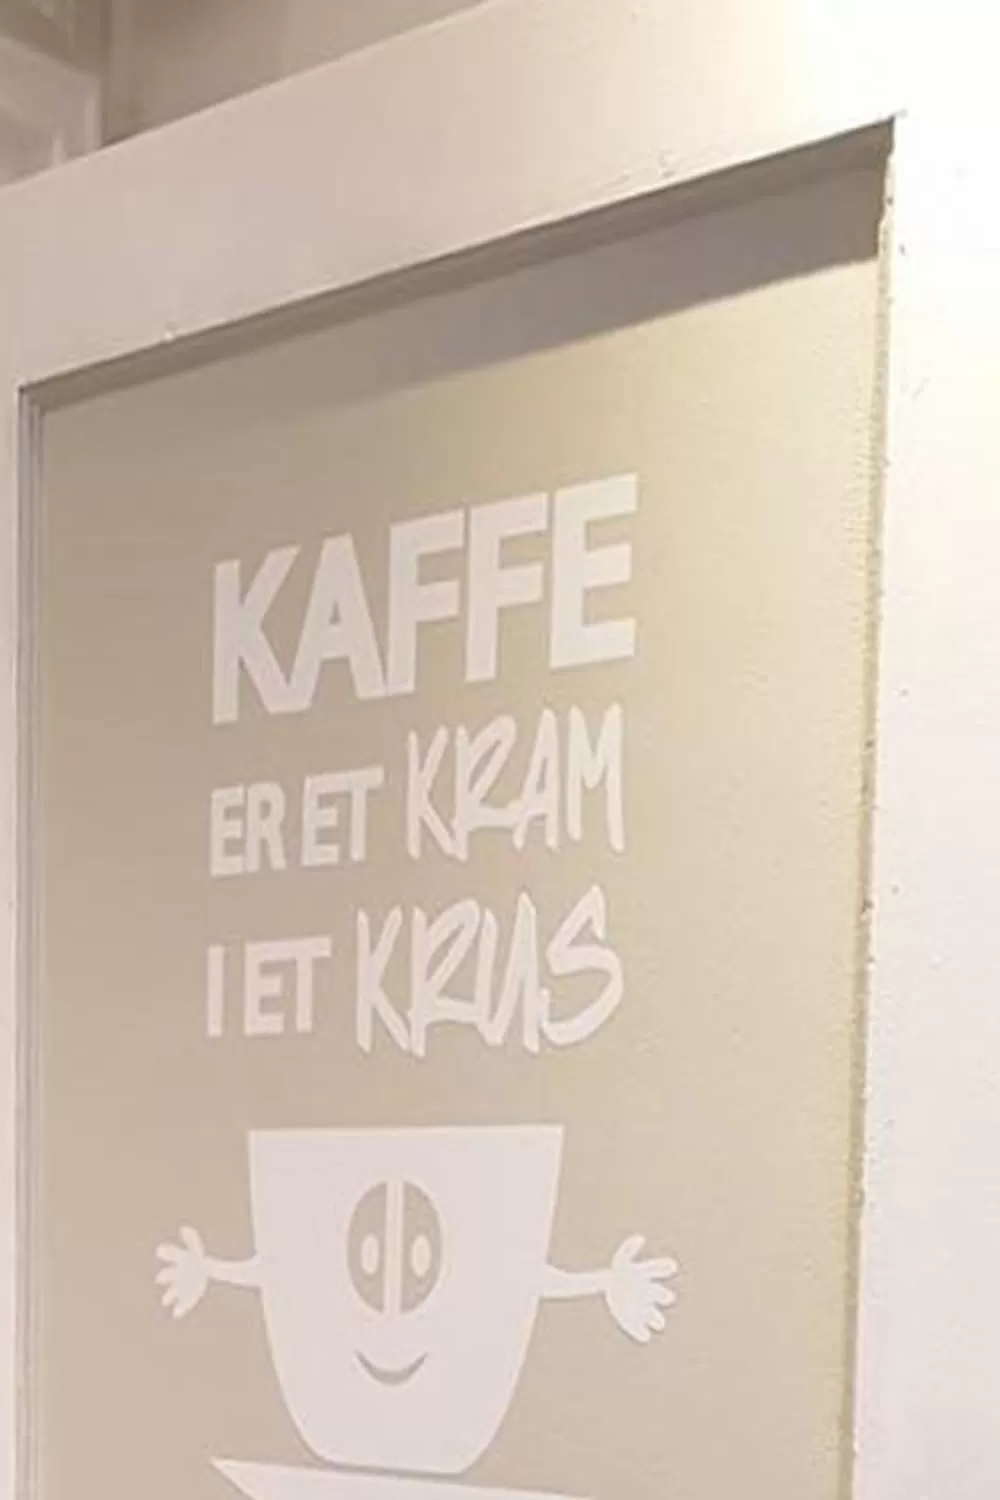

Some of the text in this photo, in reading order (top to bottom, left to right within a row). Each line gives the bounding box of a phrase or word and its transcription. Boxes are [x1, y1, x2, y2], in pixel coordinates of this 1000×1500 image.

[211, 472, 639, 724] KAFFE
[209, 702, 625, 877] ER ET KRAM
[206, 884, 626, 1058] I ET KRUS
